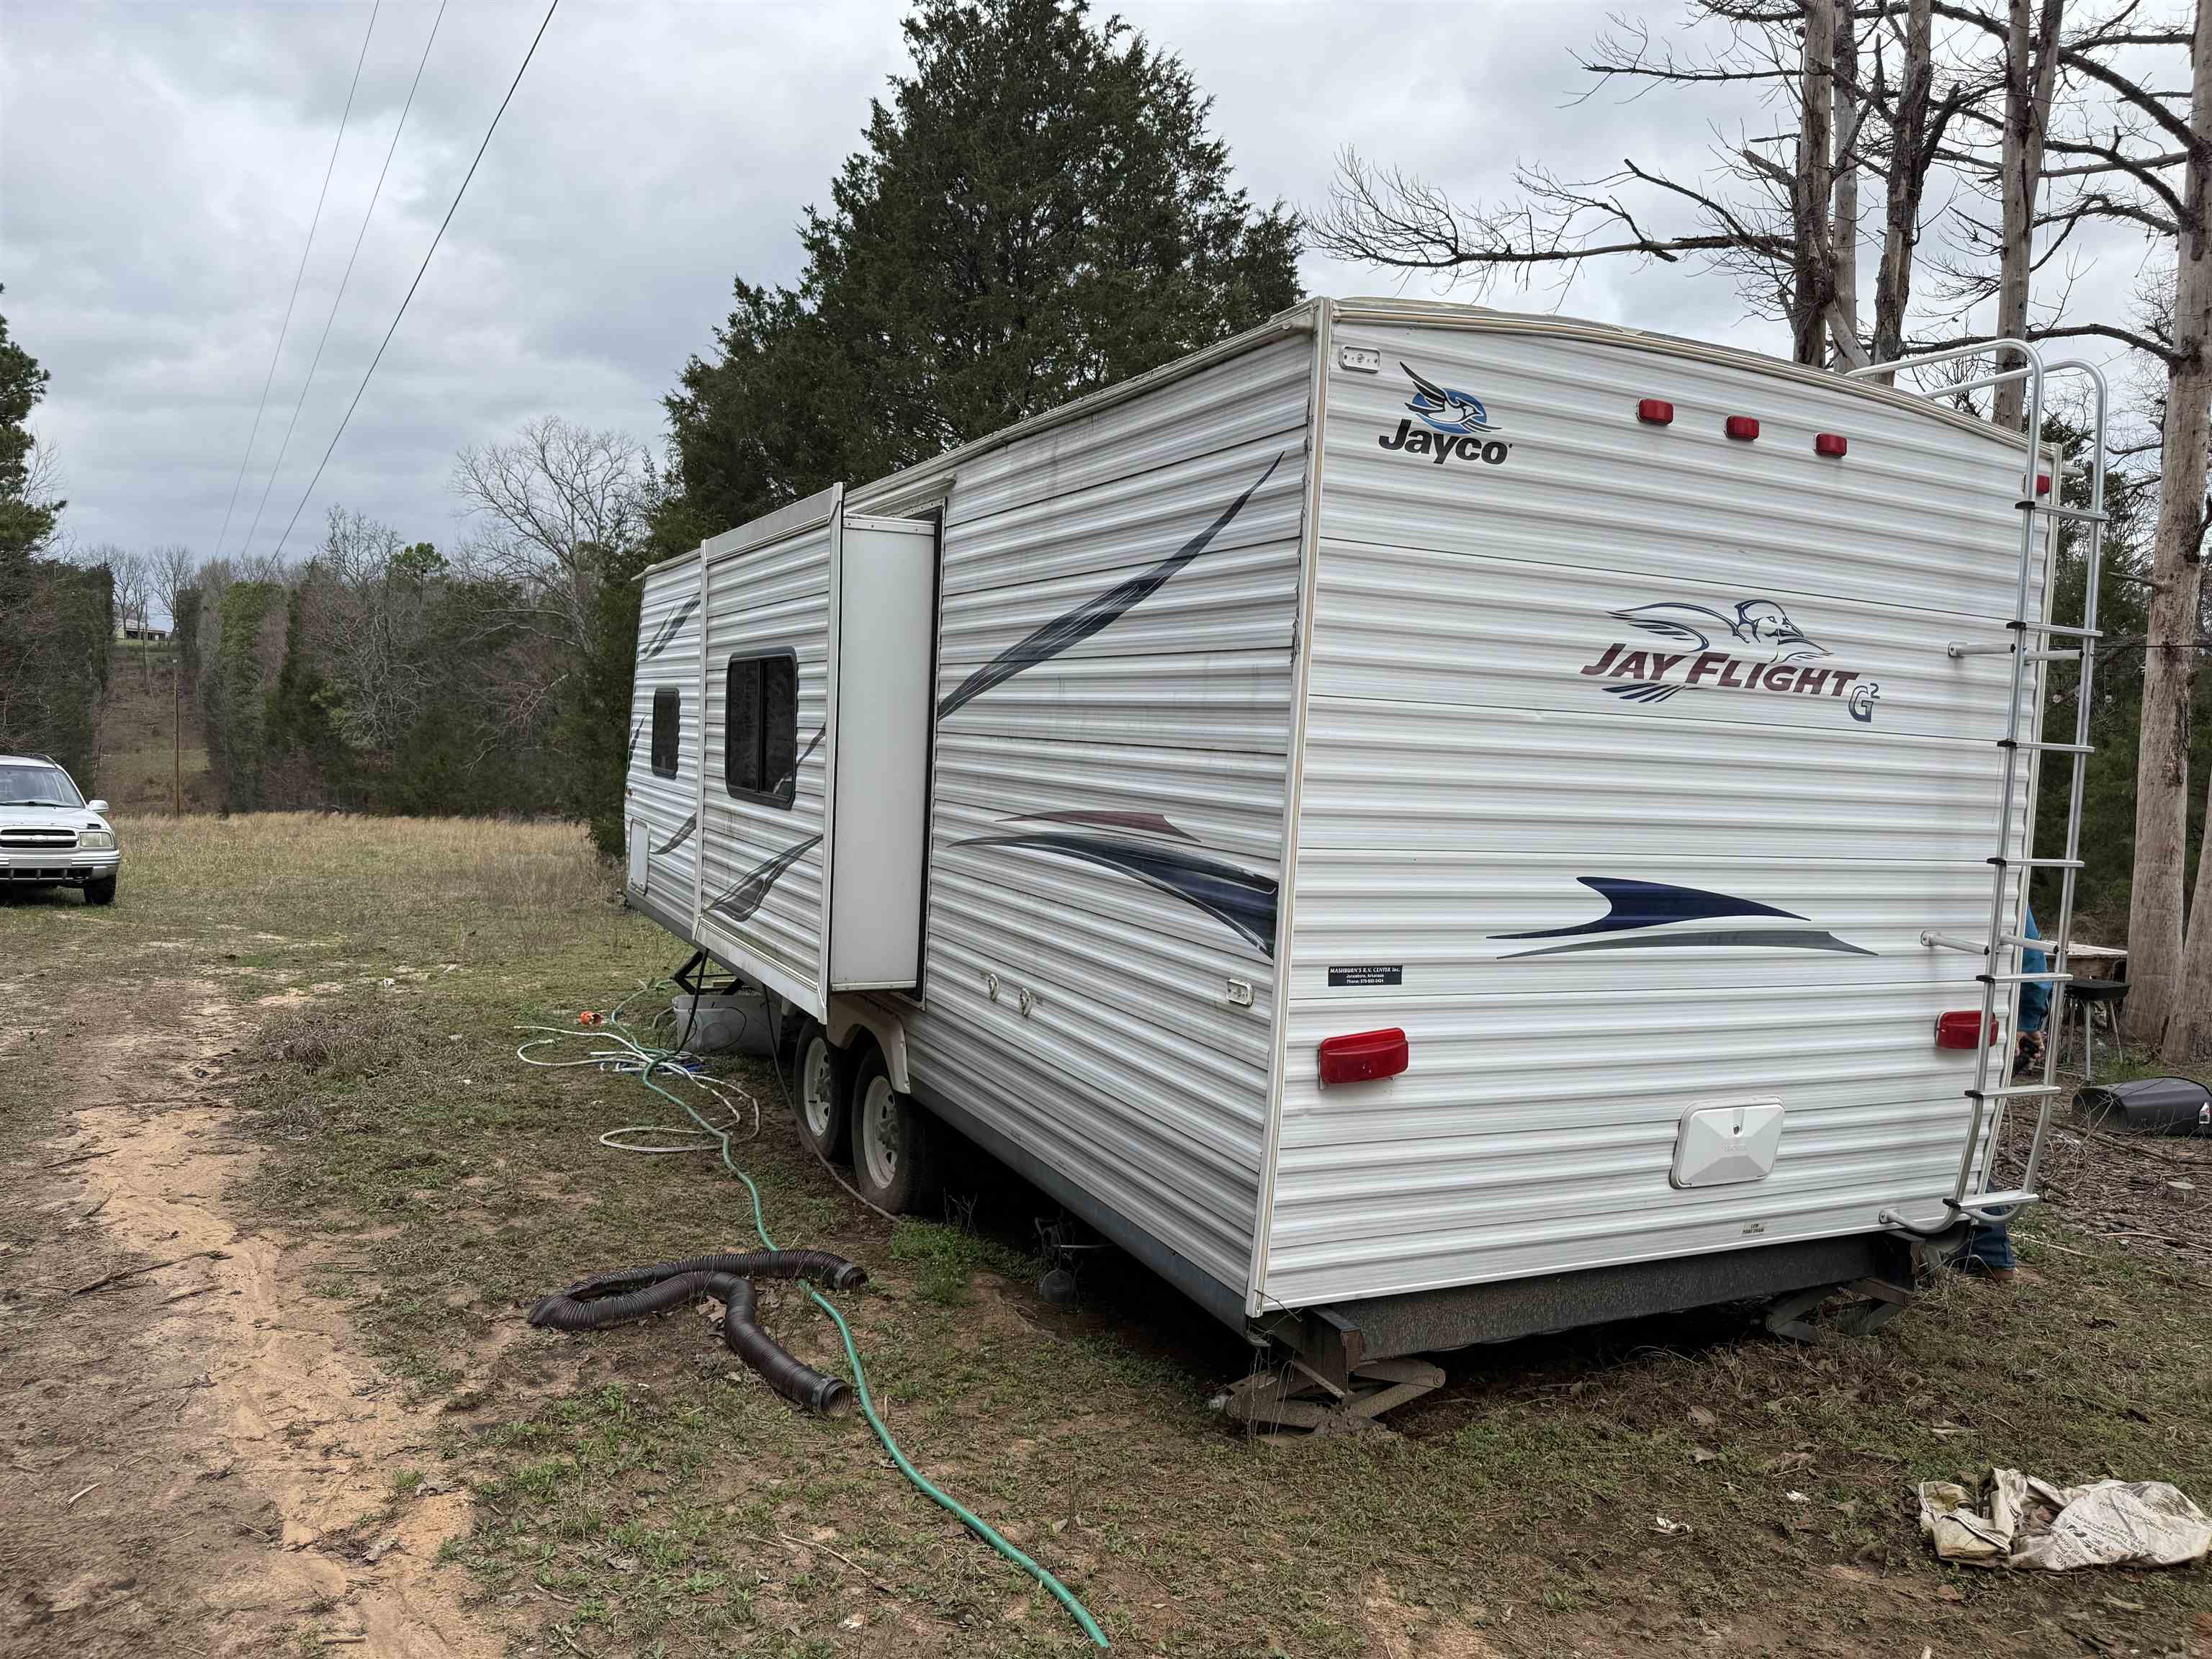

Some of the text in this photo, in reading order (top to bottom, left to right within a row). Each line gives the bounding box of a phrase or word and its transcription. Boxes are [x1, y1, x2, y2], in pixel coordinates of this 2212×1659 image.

[1378, 418, 1509, 465] Jayco
[1580, 643, 1681, 681] JAY
[1686, 652, 1861, 697] FLIGHT
